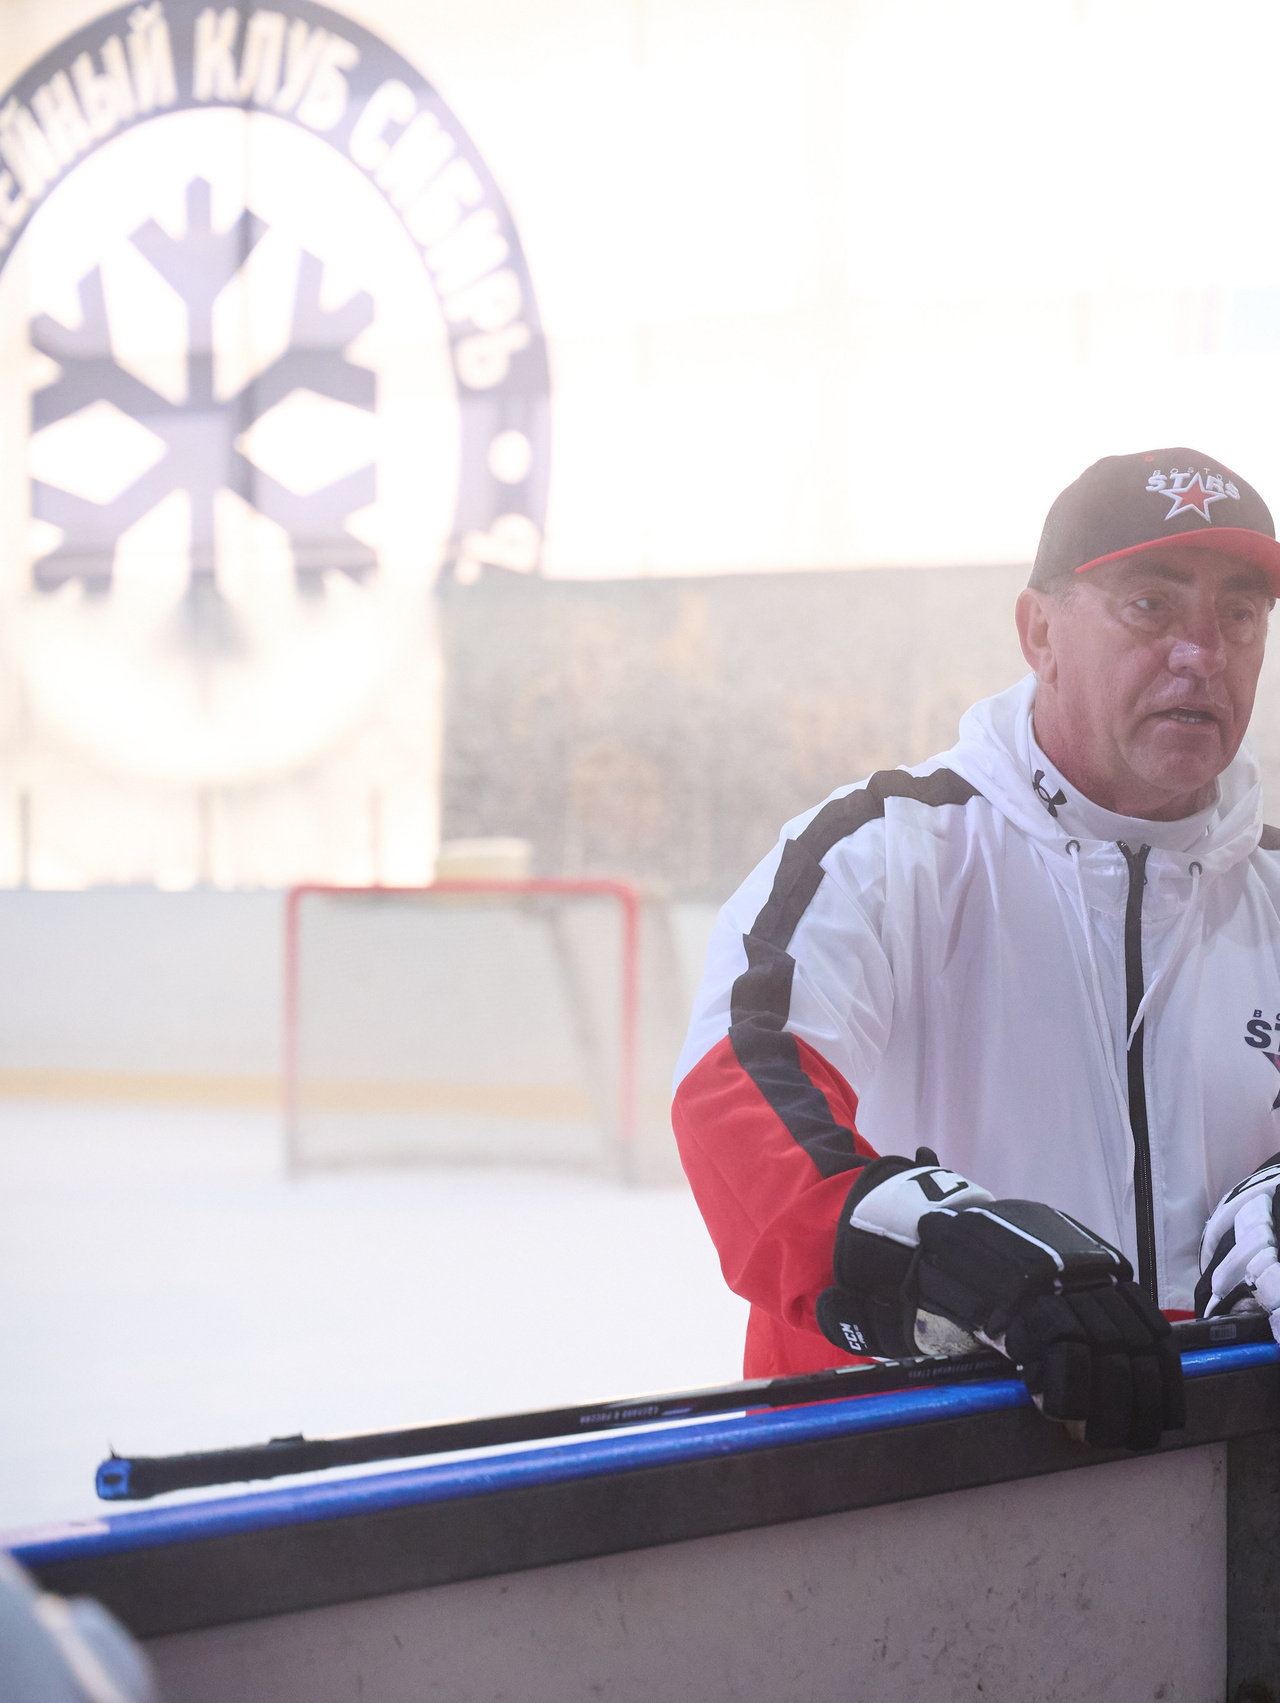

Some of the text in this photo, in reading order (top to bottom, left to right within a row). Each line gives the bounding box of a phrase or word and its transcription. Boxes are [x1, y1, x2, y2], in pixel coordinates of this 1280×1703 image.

[192, 8, 360, 131] КЛУБ
[348, 79, 532, 391] СИБИРЬ
[839, 1321, 862, 1351] CCM
